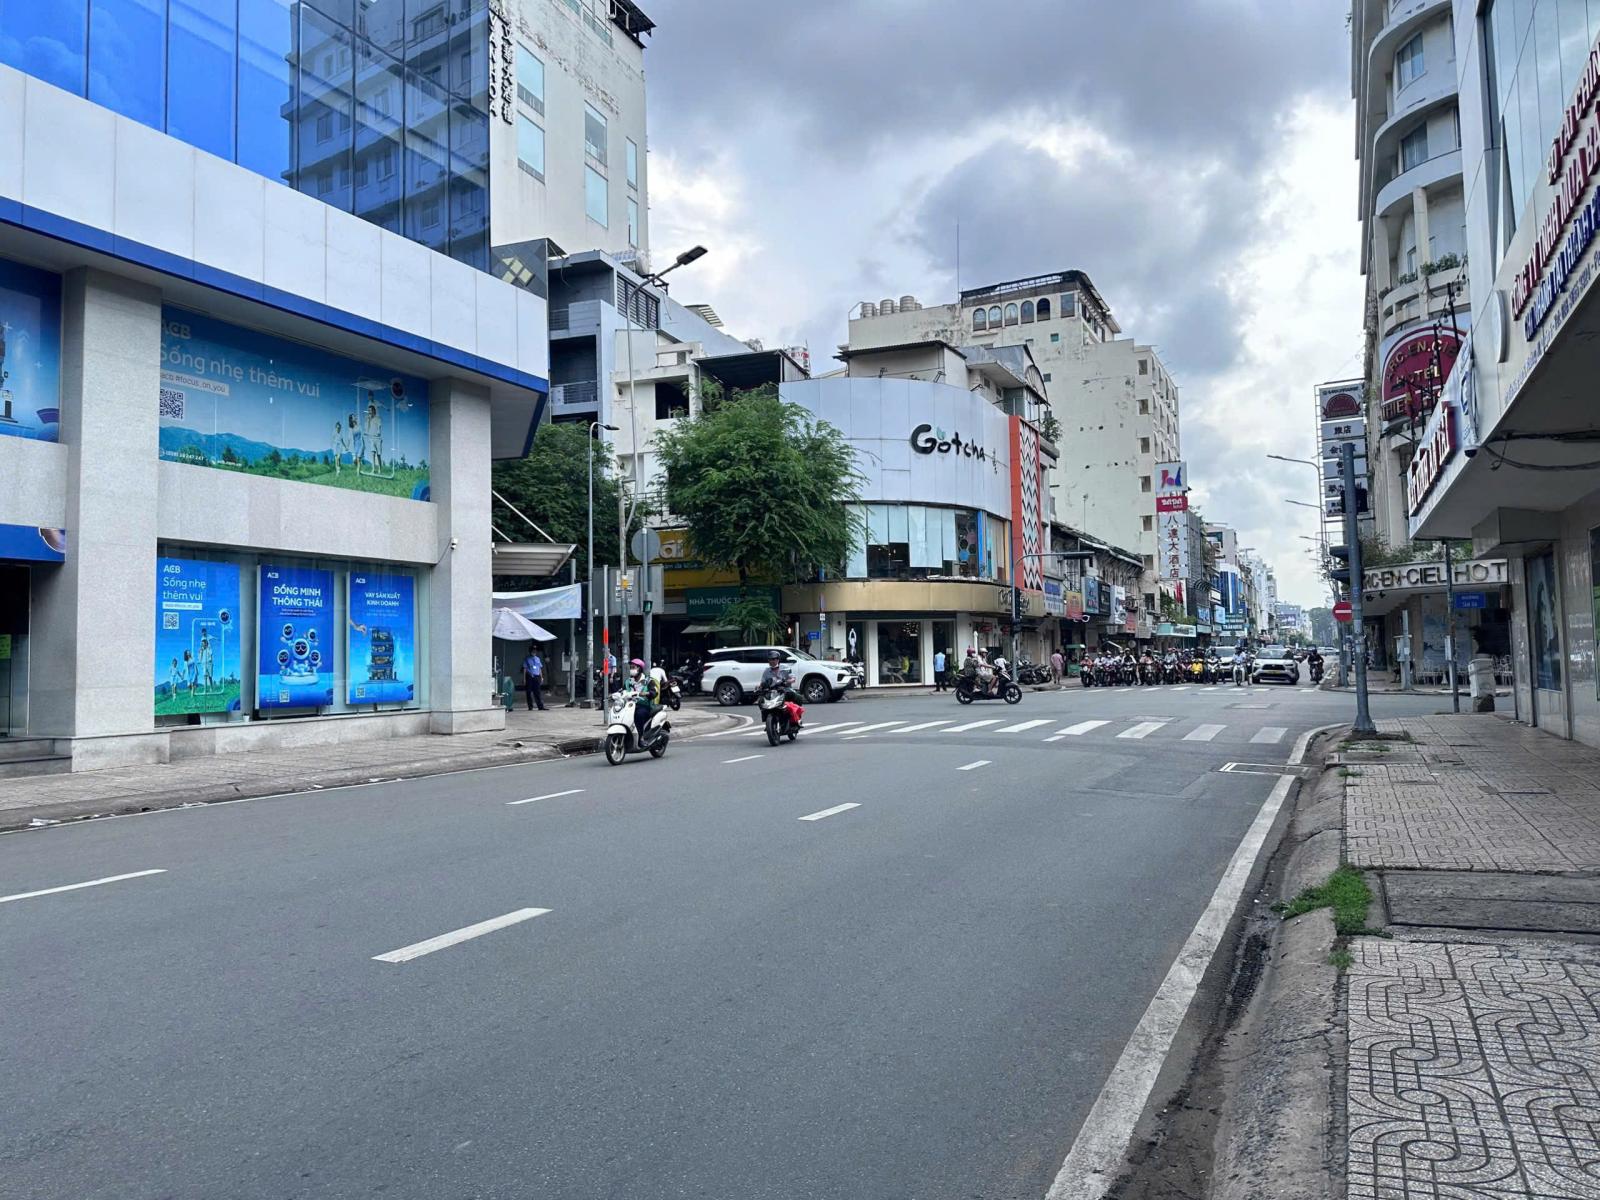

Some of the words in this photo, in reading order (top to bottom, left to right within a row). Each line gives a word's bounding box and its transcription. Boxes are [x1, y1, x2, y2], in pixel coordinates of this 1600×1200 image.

[1539, 202, 1559, 268] TNHH
[1560, 149, 1584, 224] MUA
[210, 357, 244, 383] nhẹ
[249, 366, 293, 391] thêm
[297, 380, 320, 398] vui
[911, 424, 986, 462] Gotcha
[163, 565, 181, 573] ACB
[300, 587, 321, 596] MINH
[303, 597, 323, 608] THÁI
